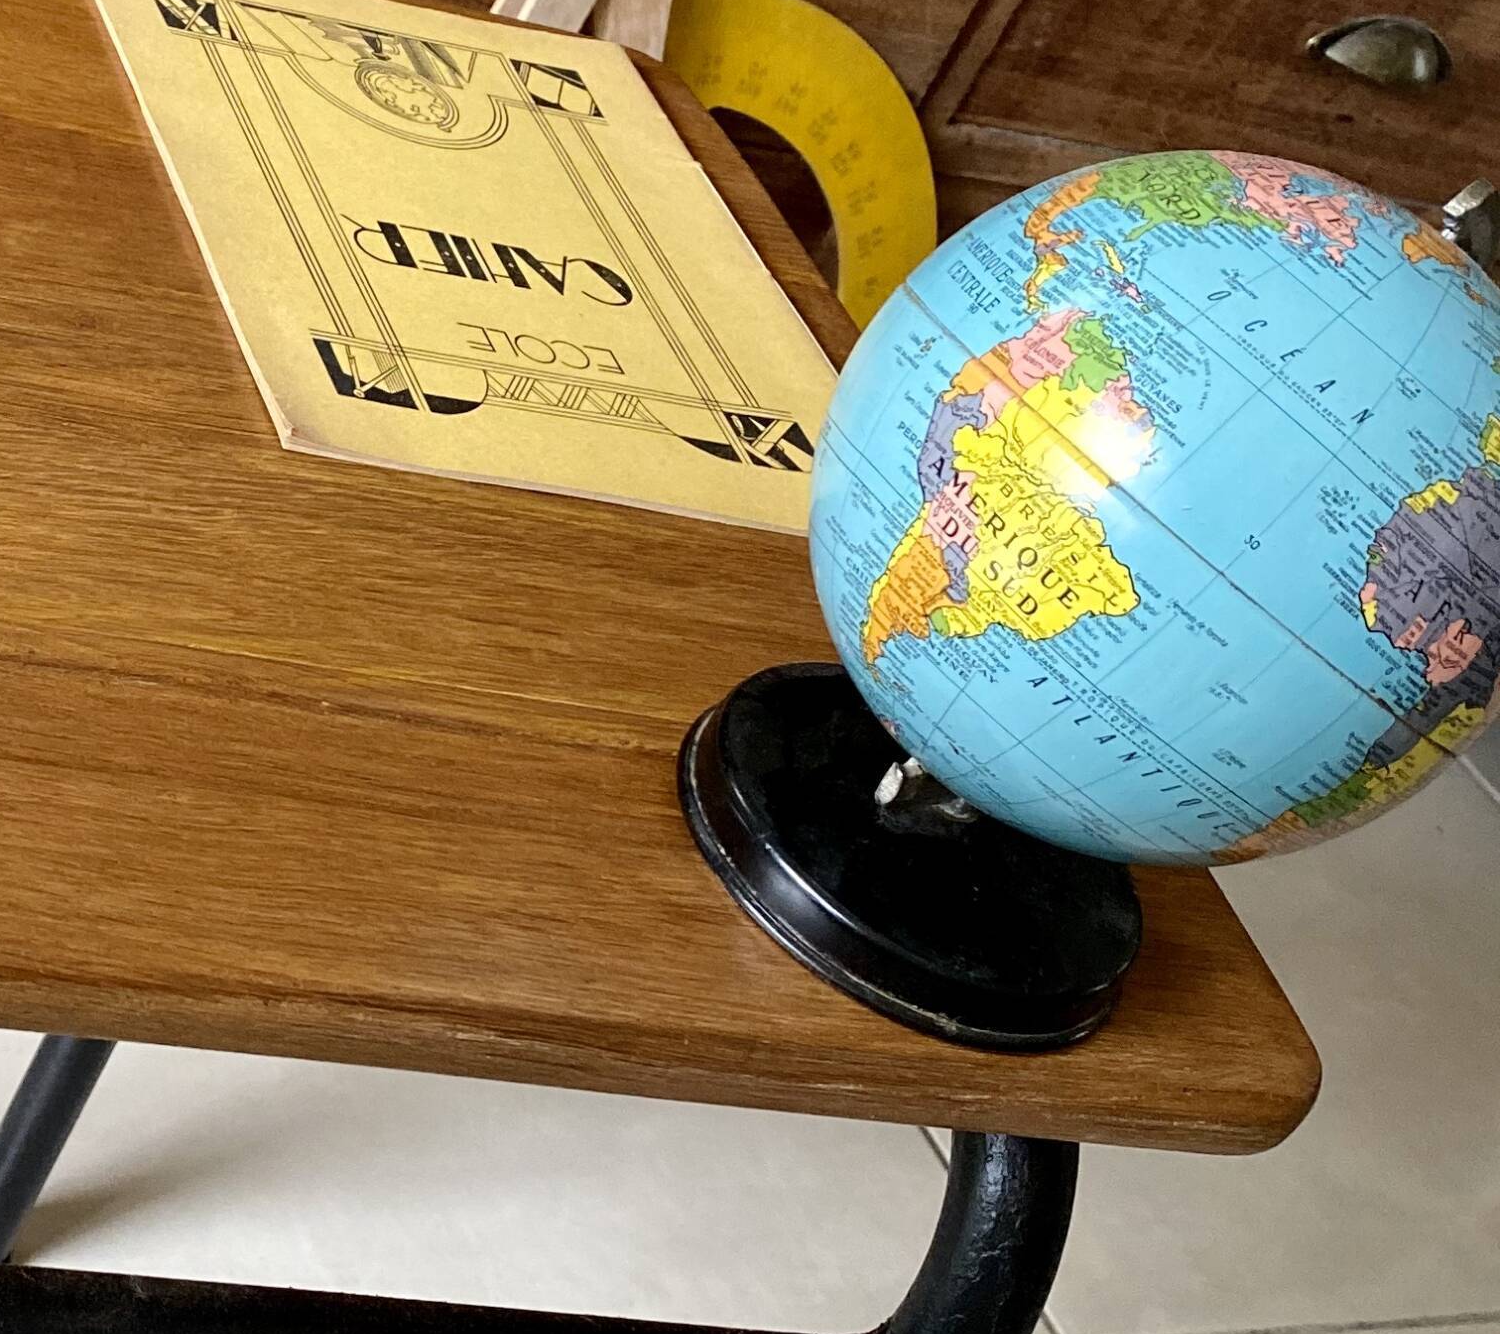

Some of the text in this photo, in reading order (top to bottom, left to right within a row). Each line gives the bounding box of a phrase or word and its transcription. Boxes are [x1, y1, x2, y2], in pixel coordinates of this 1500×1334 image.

[341, 214, 633, 308] CAHIER
[946, 257, 1001, 316] CENTRALE
[457, 322, 627, 376] ECOLE
[926, 456, 1081, 610] AMERIQUE
[939, 514, 981, 558] DU
[1242, 532, 1261, 552] 30
[980, 557, 1042, 619] SUD
[1025, 677, 1234, 833] ATLANTIQUE
